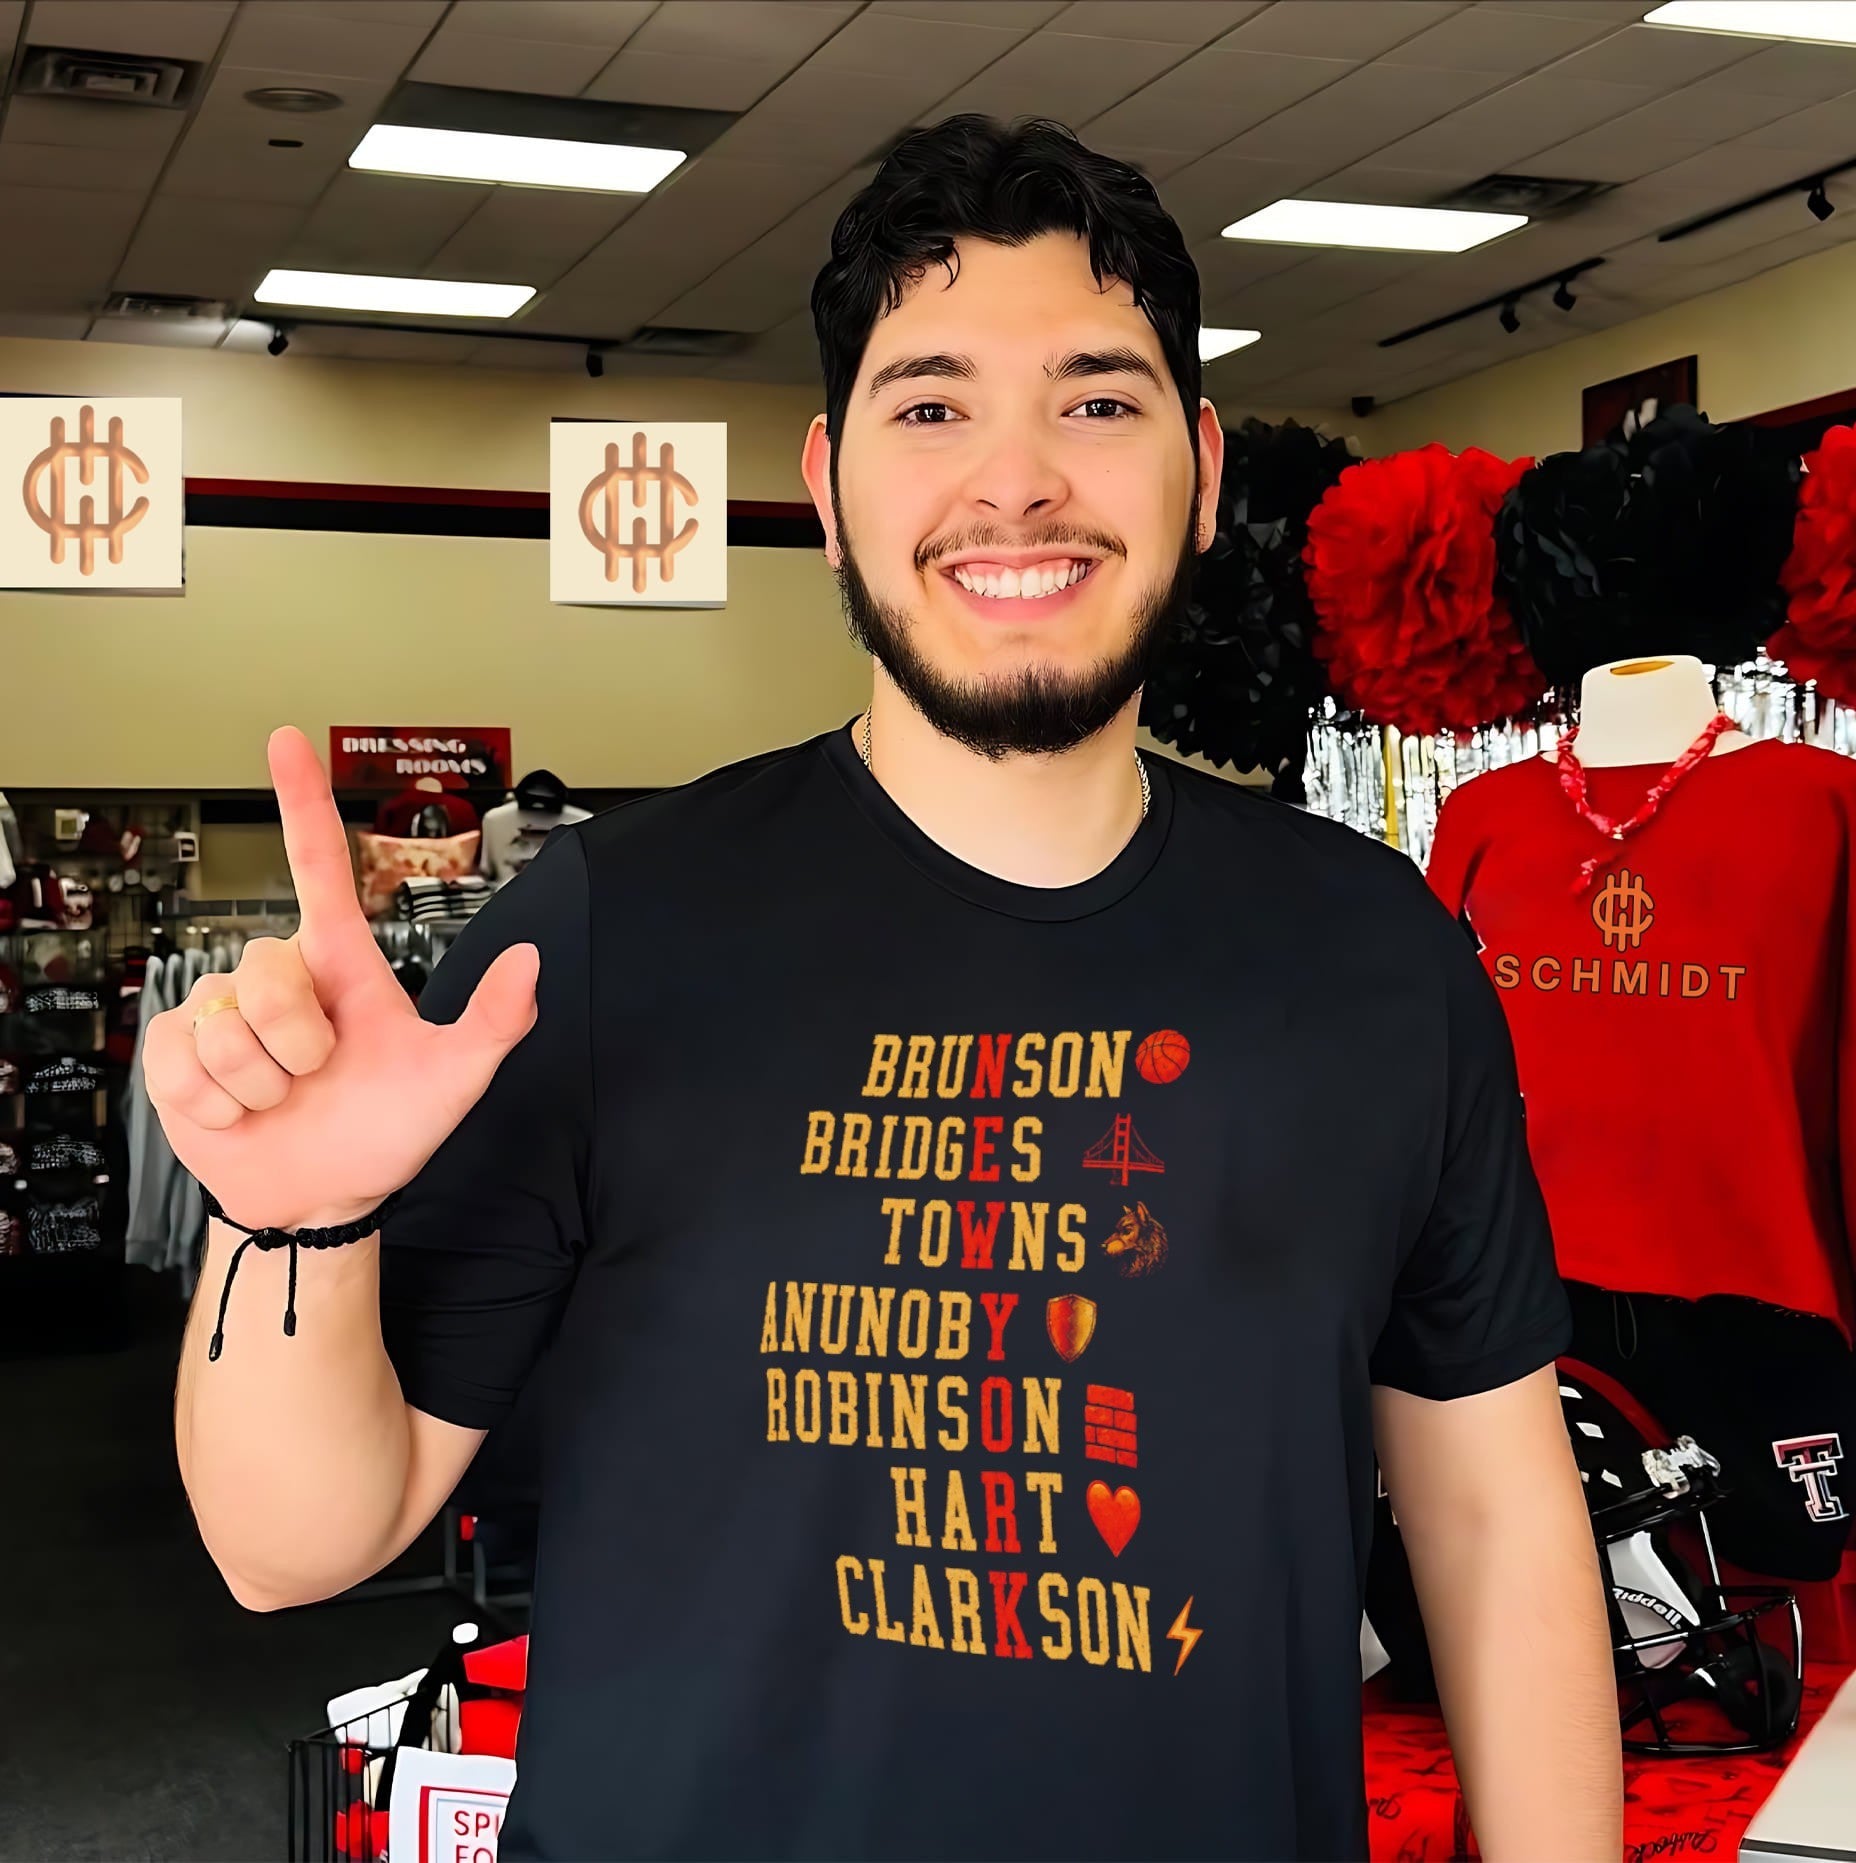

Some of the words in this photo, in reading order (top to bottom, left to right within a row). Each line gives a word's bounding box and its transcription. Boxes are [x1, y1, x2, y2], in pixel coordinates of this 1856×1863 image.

[396, 758, 488, 775] ROOMS
[1494, 954, 1747, 1001] SCHMIDT
[861, 1030, 1132, 1098] BRUNSON
[800, 1110, 1043, 1183] BRIDGES
[881, 1197, 1087, 1273] TOWNS
[760, 1281, 1020, 1361] ANUNOBY
[766, 1368, 1062, 1454] ROBINSON
[890, 1466, 1063, 1554] HART
[835, 1555, 1152, 1673] CLARKSON
